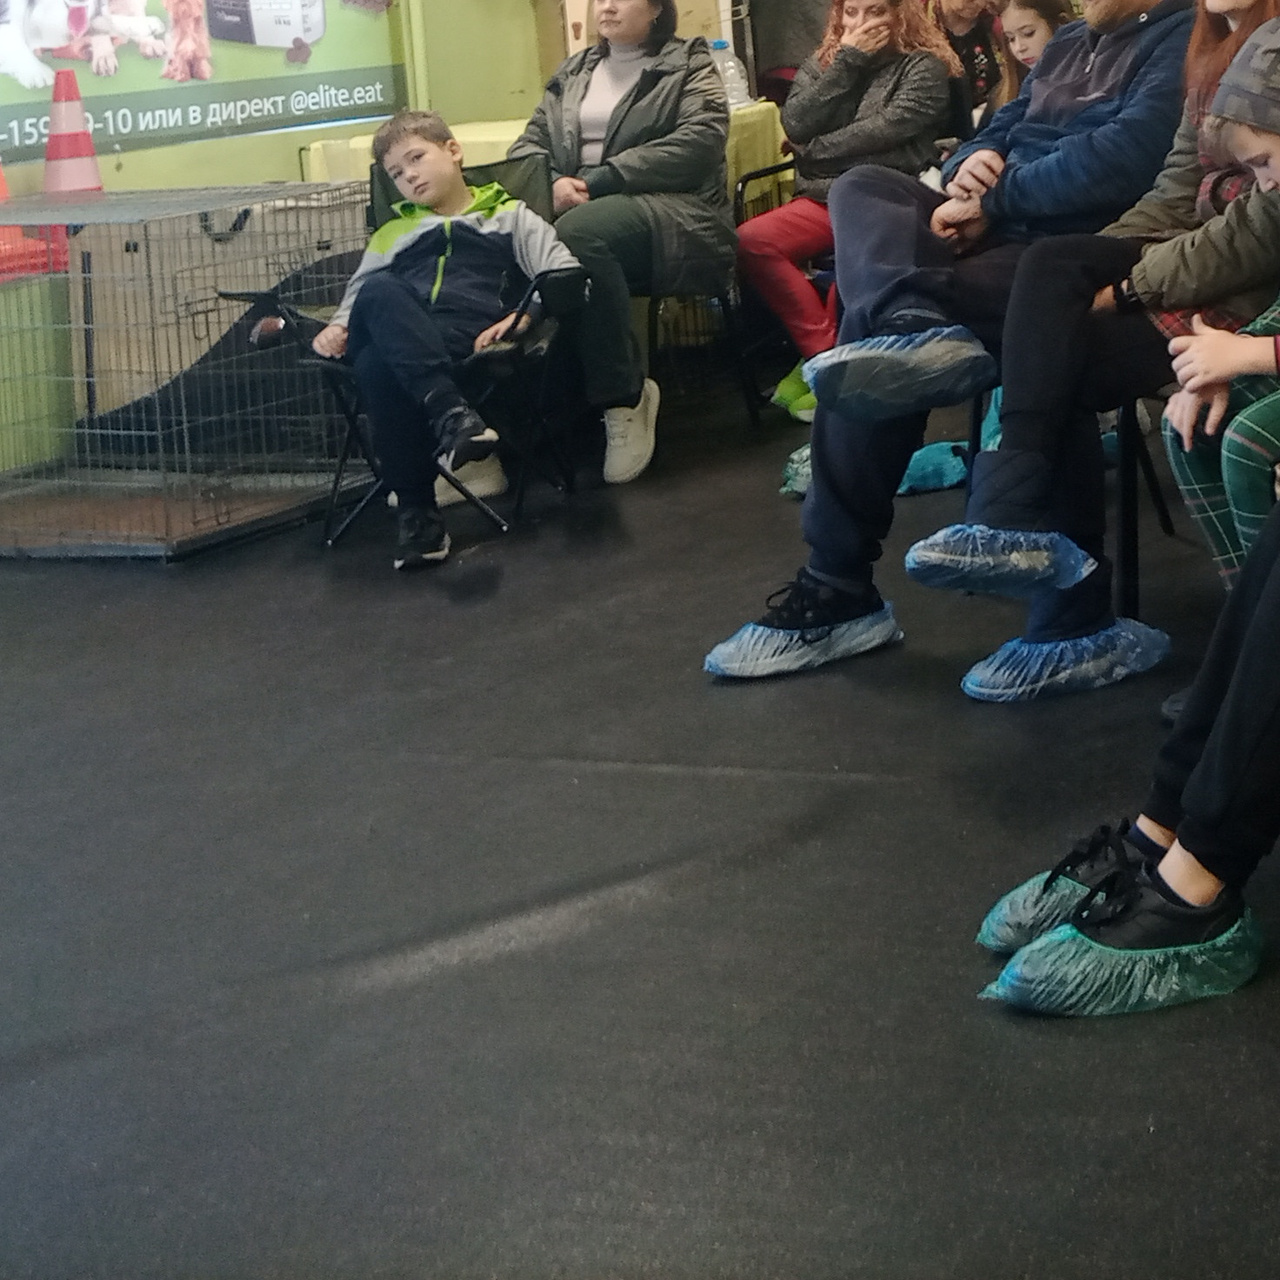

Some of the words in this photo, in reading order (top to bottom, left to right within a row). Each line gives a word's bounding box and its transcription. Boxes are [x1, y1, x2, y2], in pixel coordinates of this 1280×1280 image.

[138, 106, 182, 130] или
[189, 104, 201, 126] в
[207, 95, 285, 126] директ
[290, 81, 383, 114] @elite.eat
